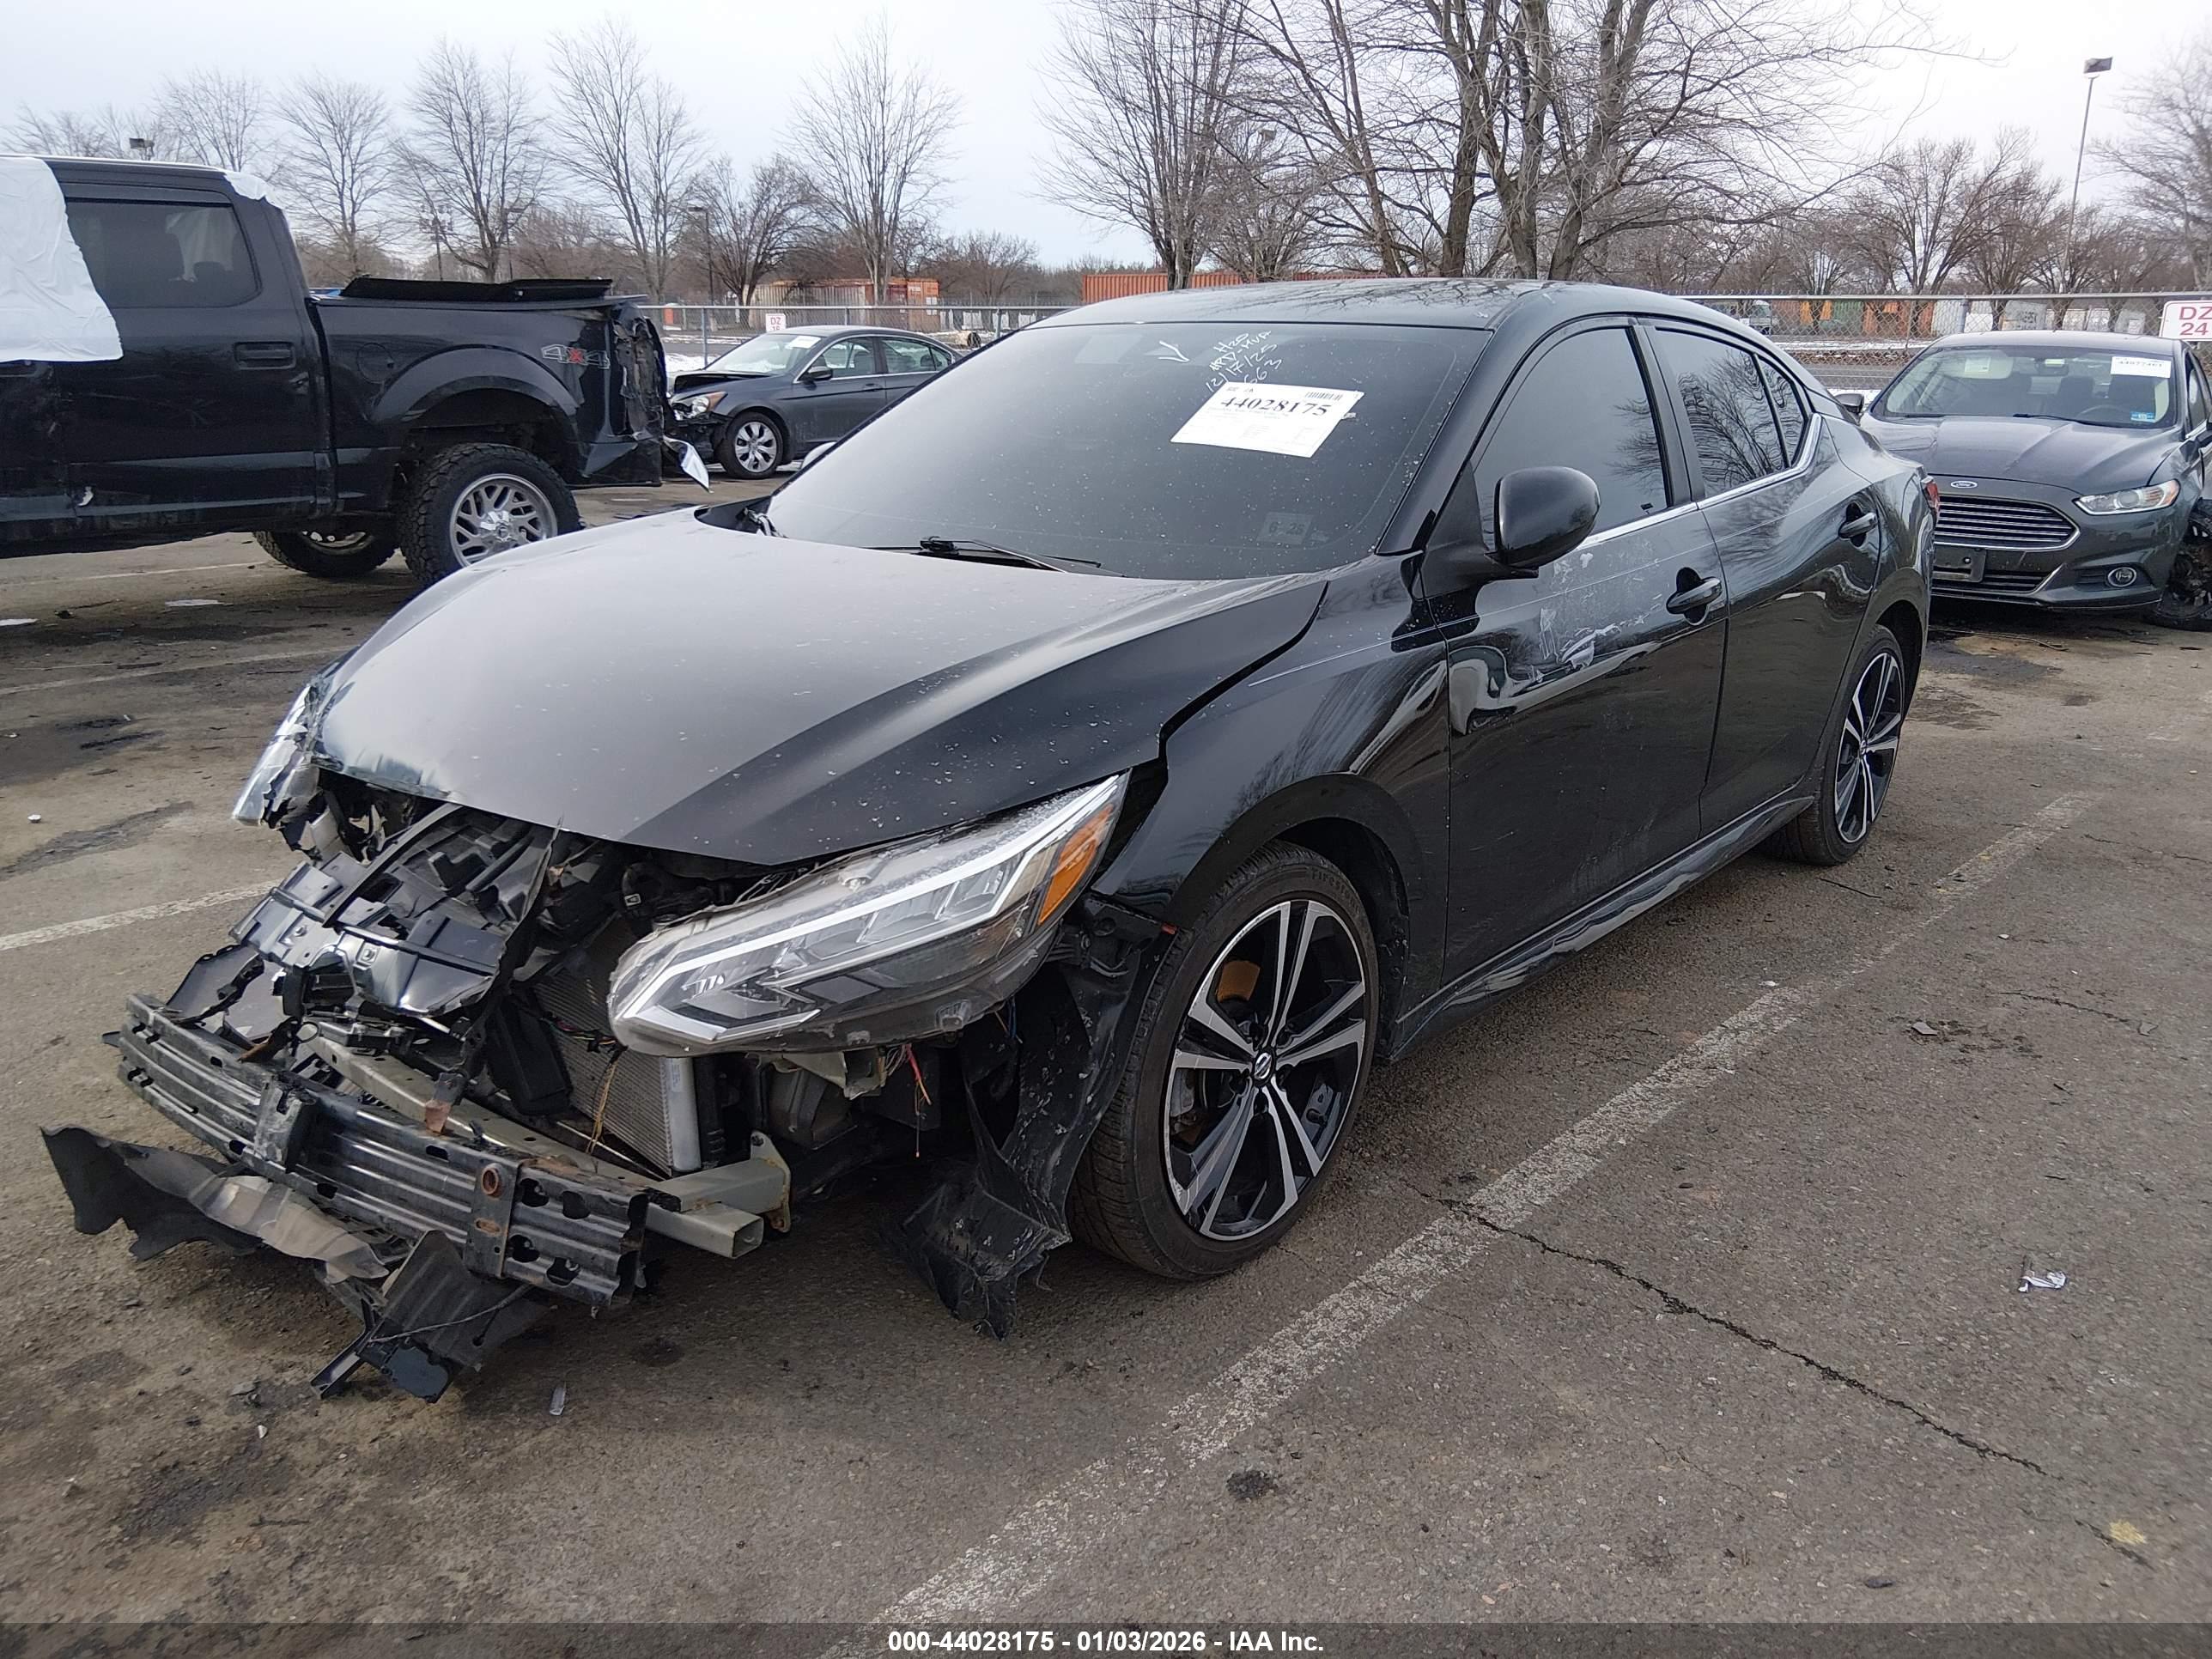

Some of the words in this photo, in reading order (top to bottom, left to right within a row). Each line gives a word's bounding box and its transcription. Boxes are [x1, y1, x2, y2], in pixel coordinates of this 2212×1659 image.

[2179, 307, 2212, 320] DZ
[770, 317, 781, 325] DZ
[2179, 322, 2209, 336] 24
[1220, 397, 1332, 416] 44028175
